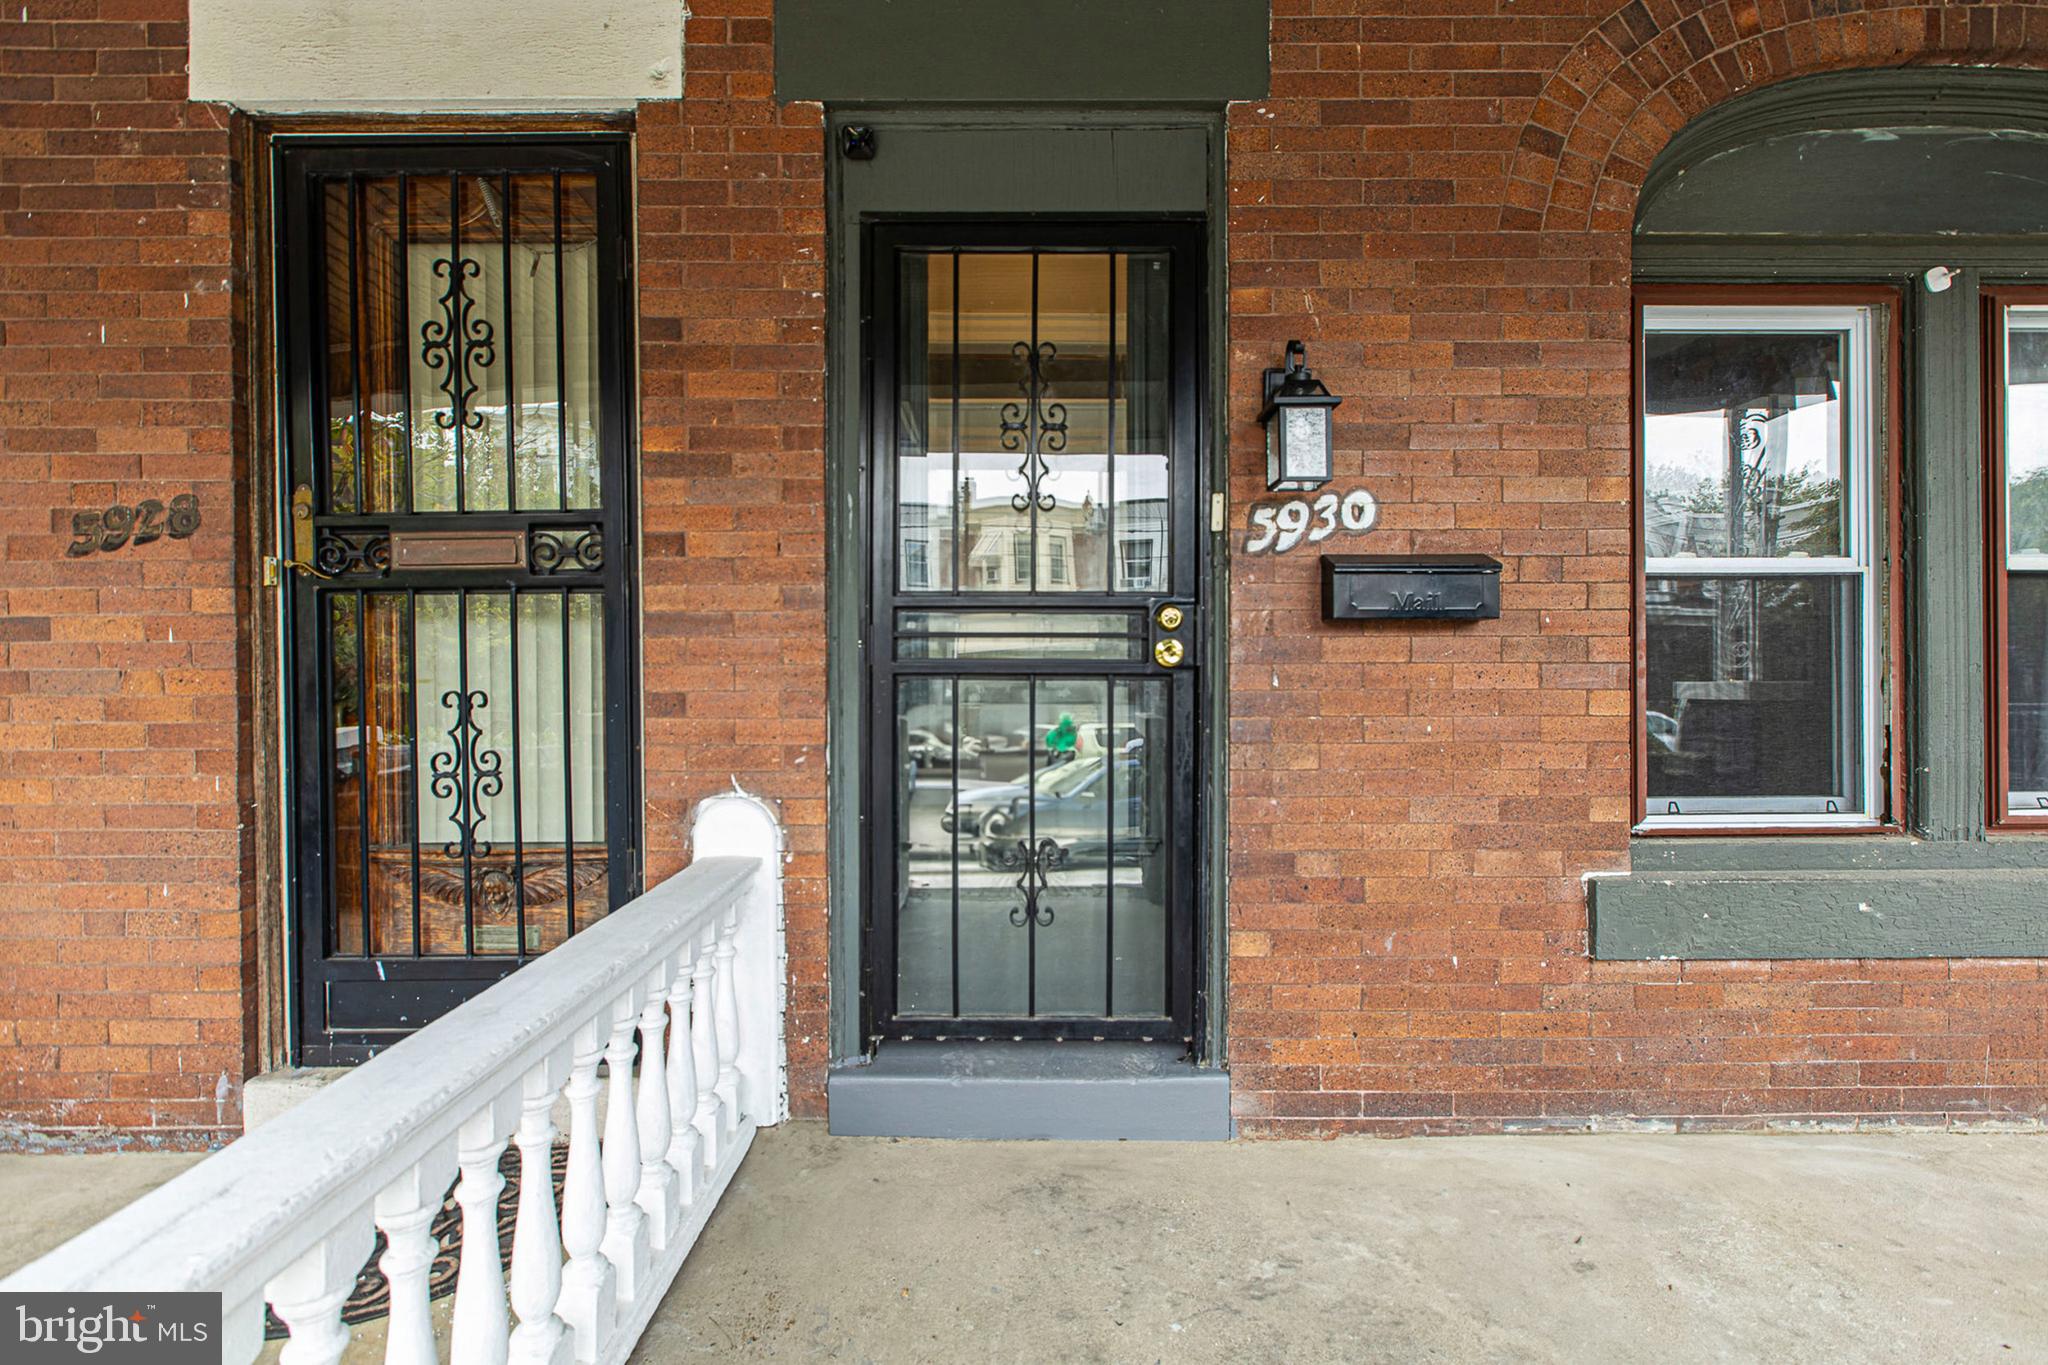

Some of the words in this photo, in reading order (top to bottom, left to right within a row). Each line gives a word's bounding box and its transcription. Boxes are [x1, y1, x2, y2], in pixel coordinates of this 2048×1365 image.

[65, 494, 200, 557] 5928
[1246, 488, 1377, 553] 5930
[1390, 591, 1443, 611] Mail
